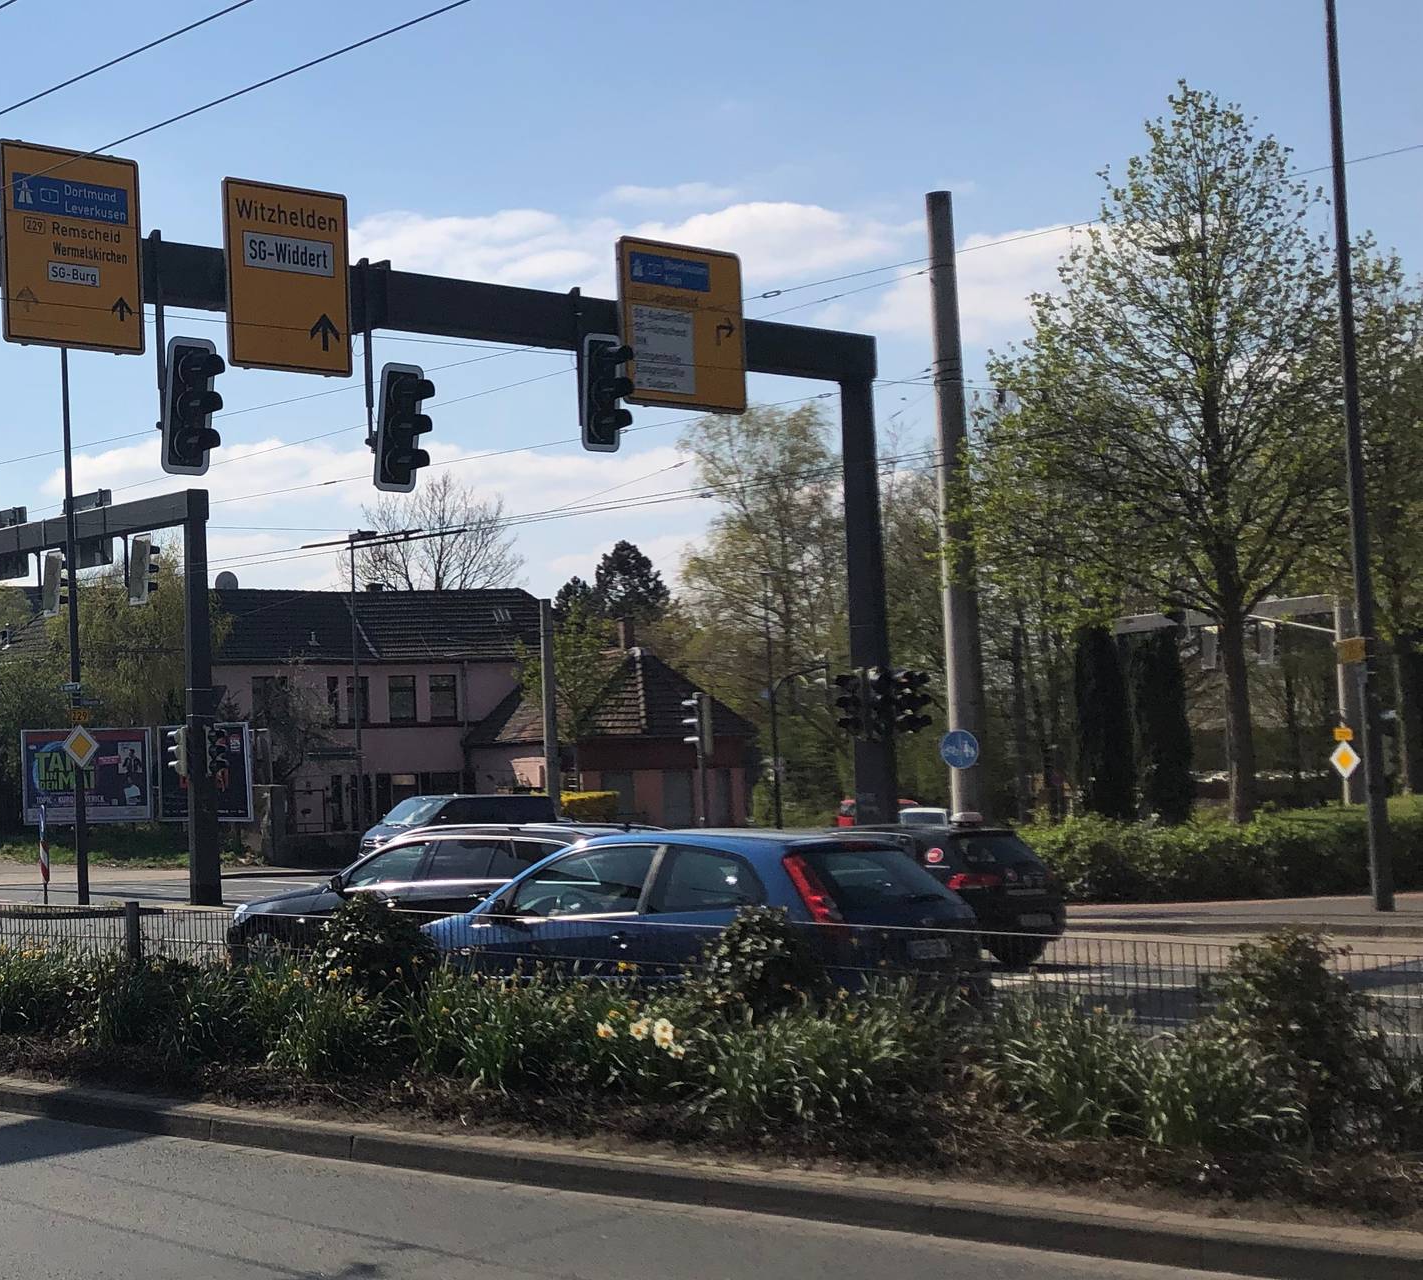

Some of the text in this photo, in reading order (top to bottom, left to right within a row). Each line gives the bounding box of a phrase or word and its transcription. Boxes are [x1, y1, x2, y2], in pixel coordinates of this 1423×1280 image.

[64, 184, 117, 203] Dortmund
[65, 201, 126, 221] Leverkusen
[235, 198, 338, 232] Witzhelden
[26, 220, 121, 243] 229 Remscheid
[52, 242, 128, 265] Wermelskirchen
[249, 239, 328, 269] SG-Widdert
[51, 266, 97, 285] SG-Burg
[72, 711, 88, 721] 229
